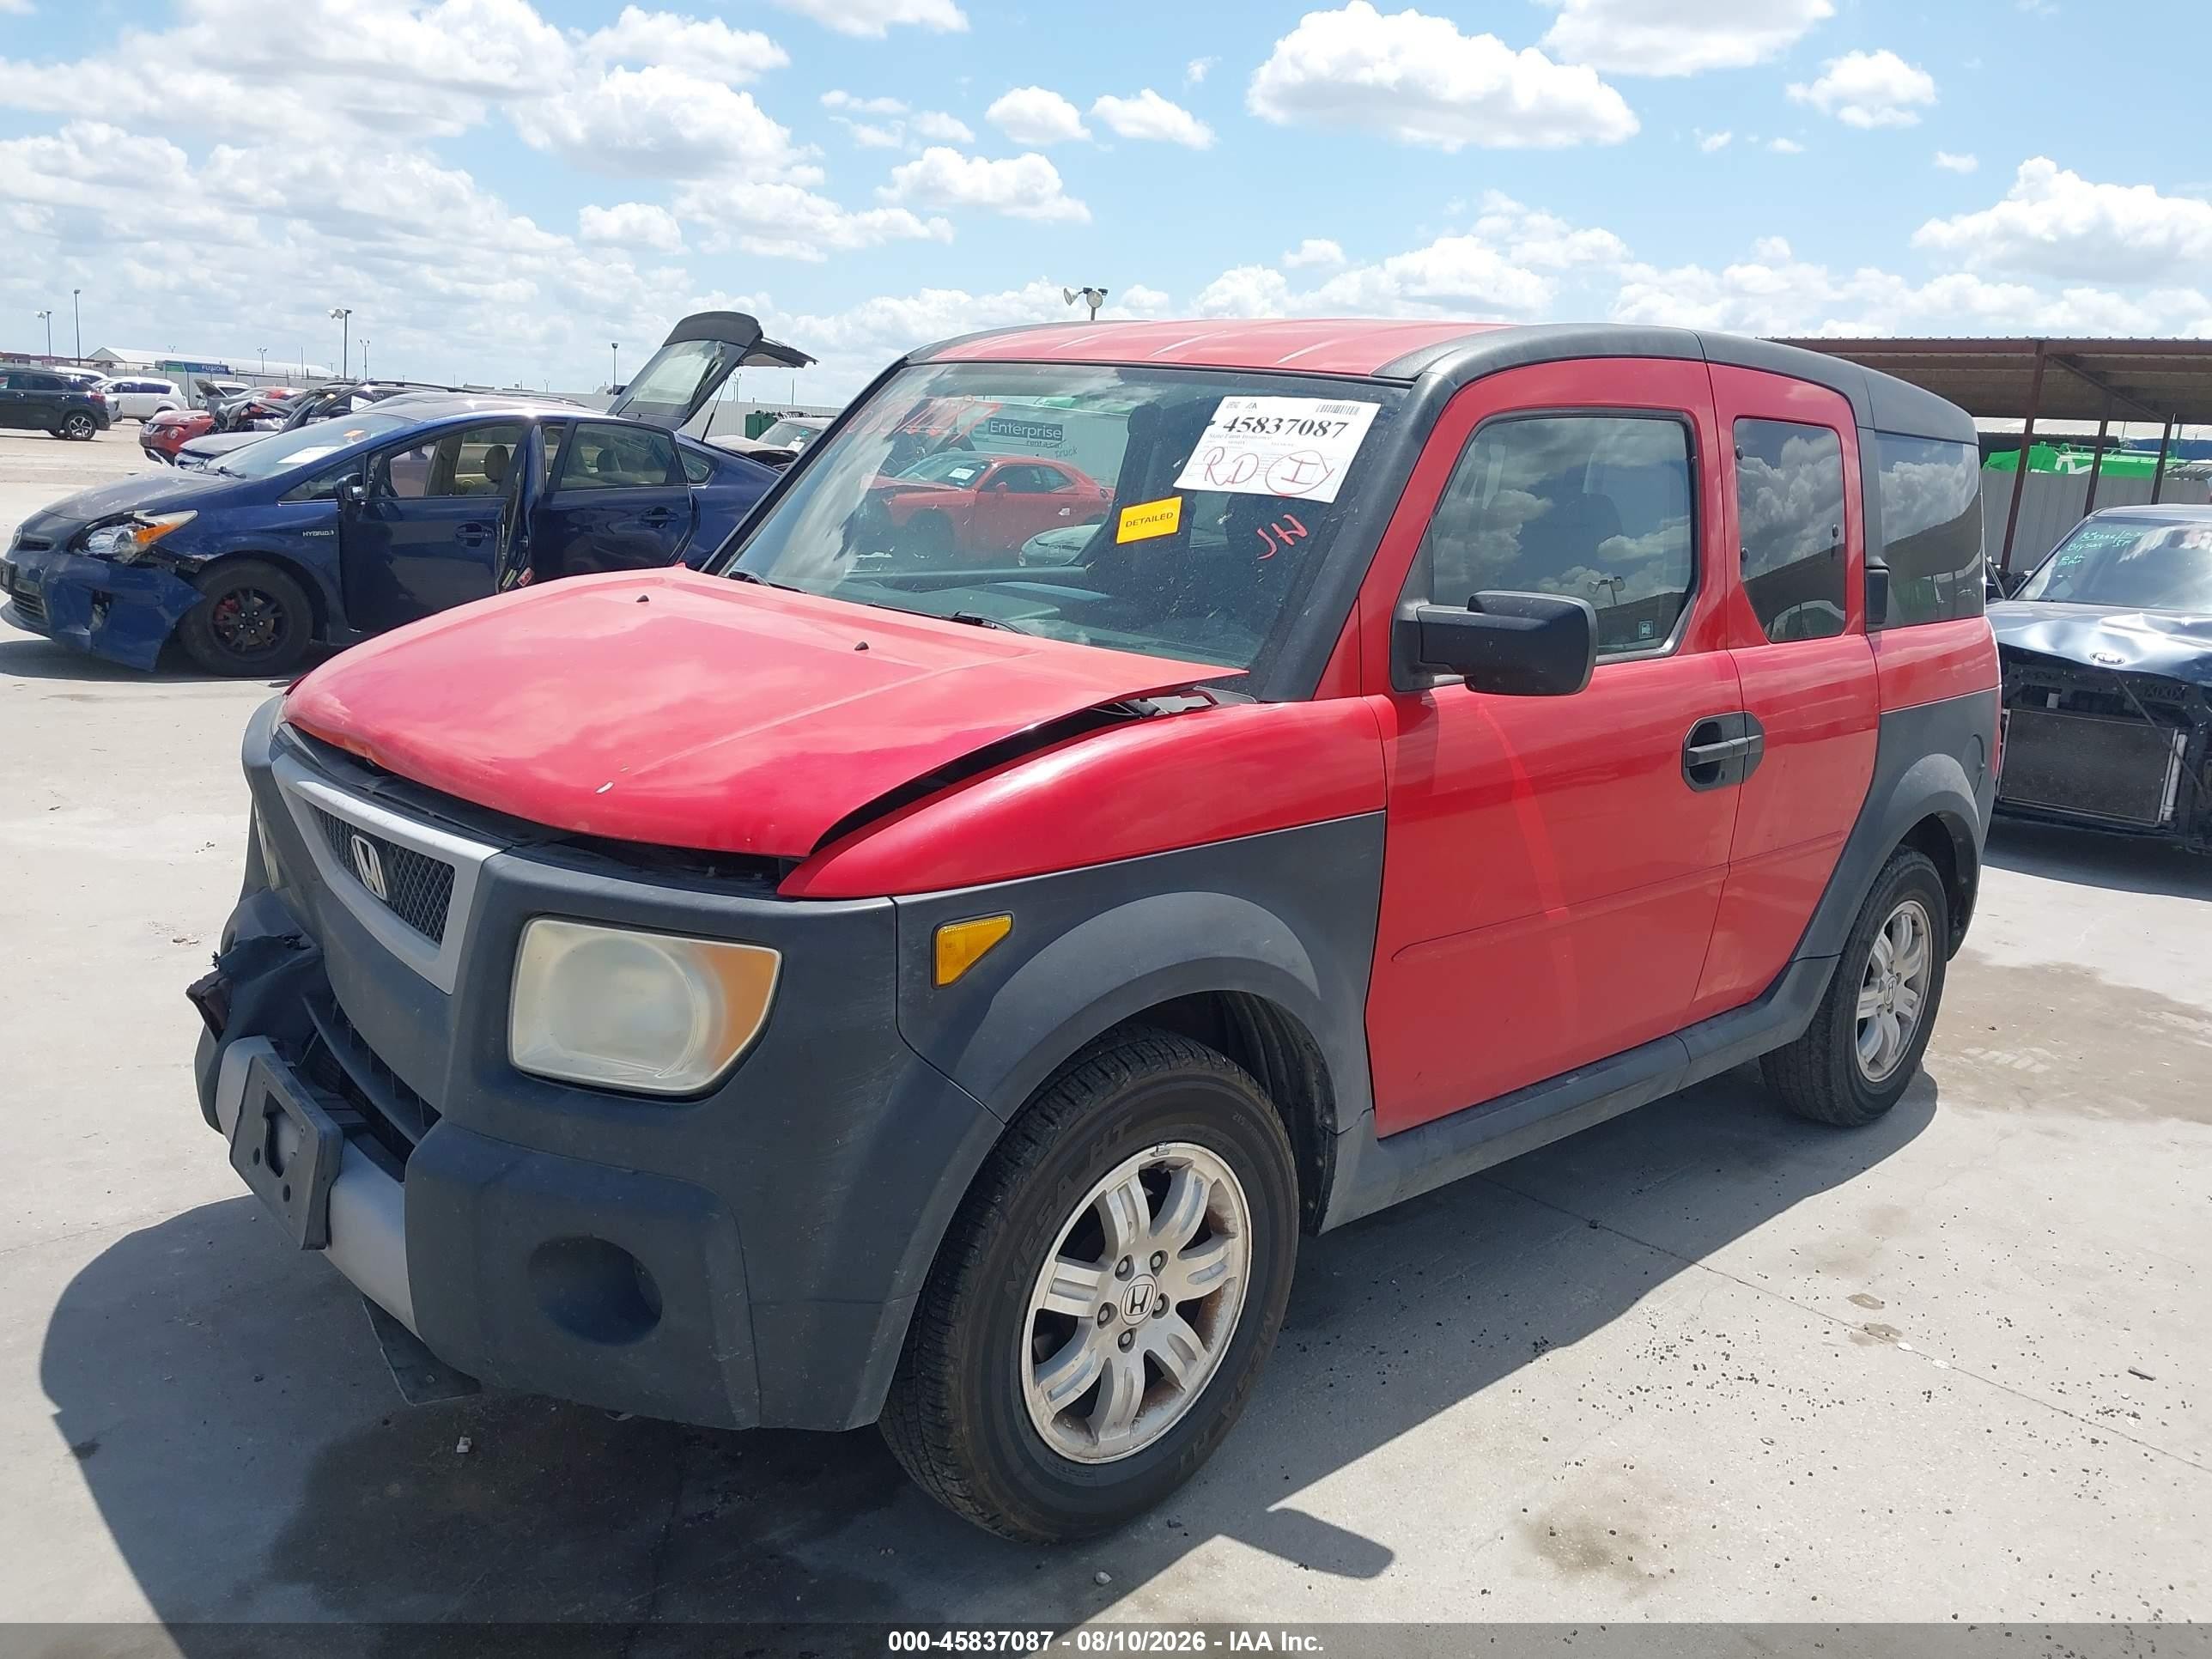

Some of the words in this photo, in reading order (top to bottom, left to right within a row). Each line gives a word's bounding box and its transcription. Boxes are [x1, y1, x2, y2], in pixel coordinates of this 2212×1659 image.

[989, 421, 1062, 439] Enterprise
[1222, 416, 1350, 439] 45837087
[1125, 511, 1174, 528] DETAILED
